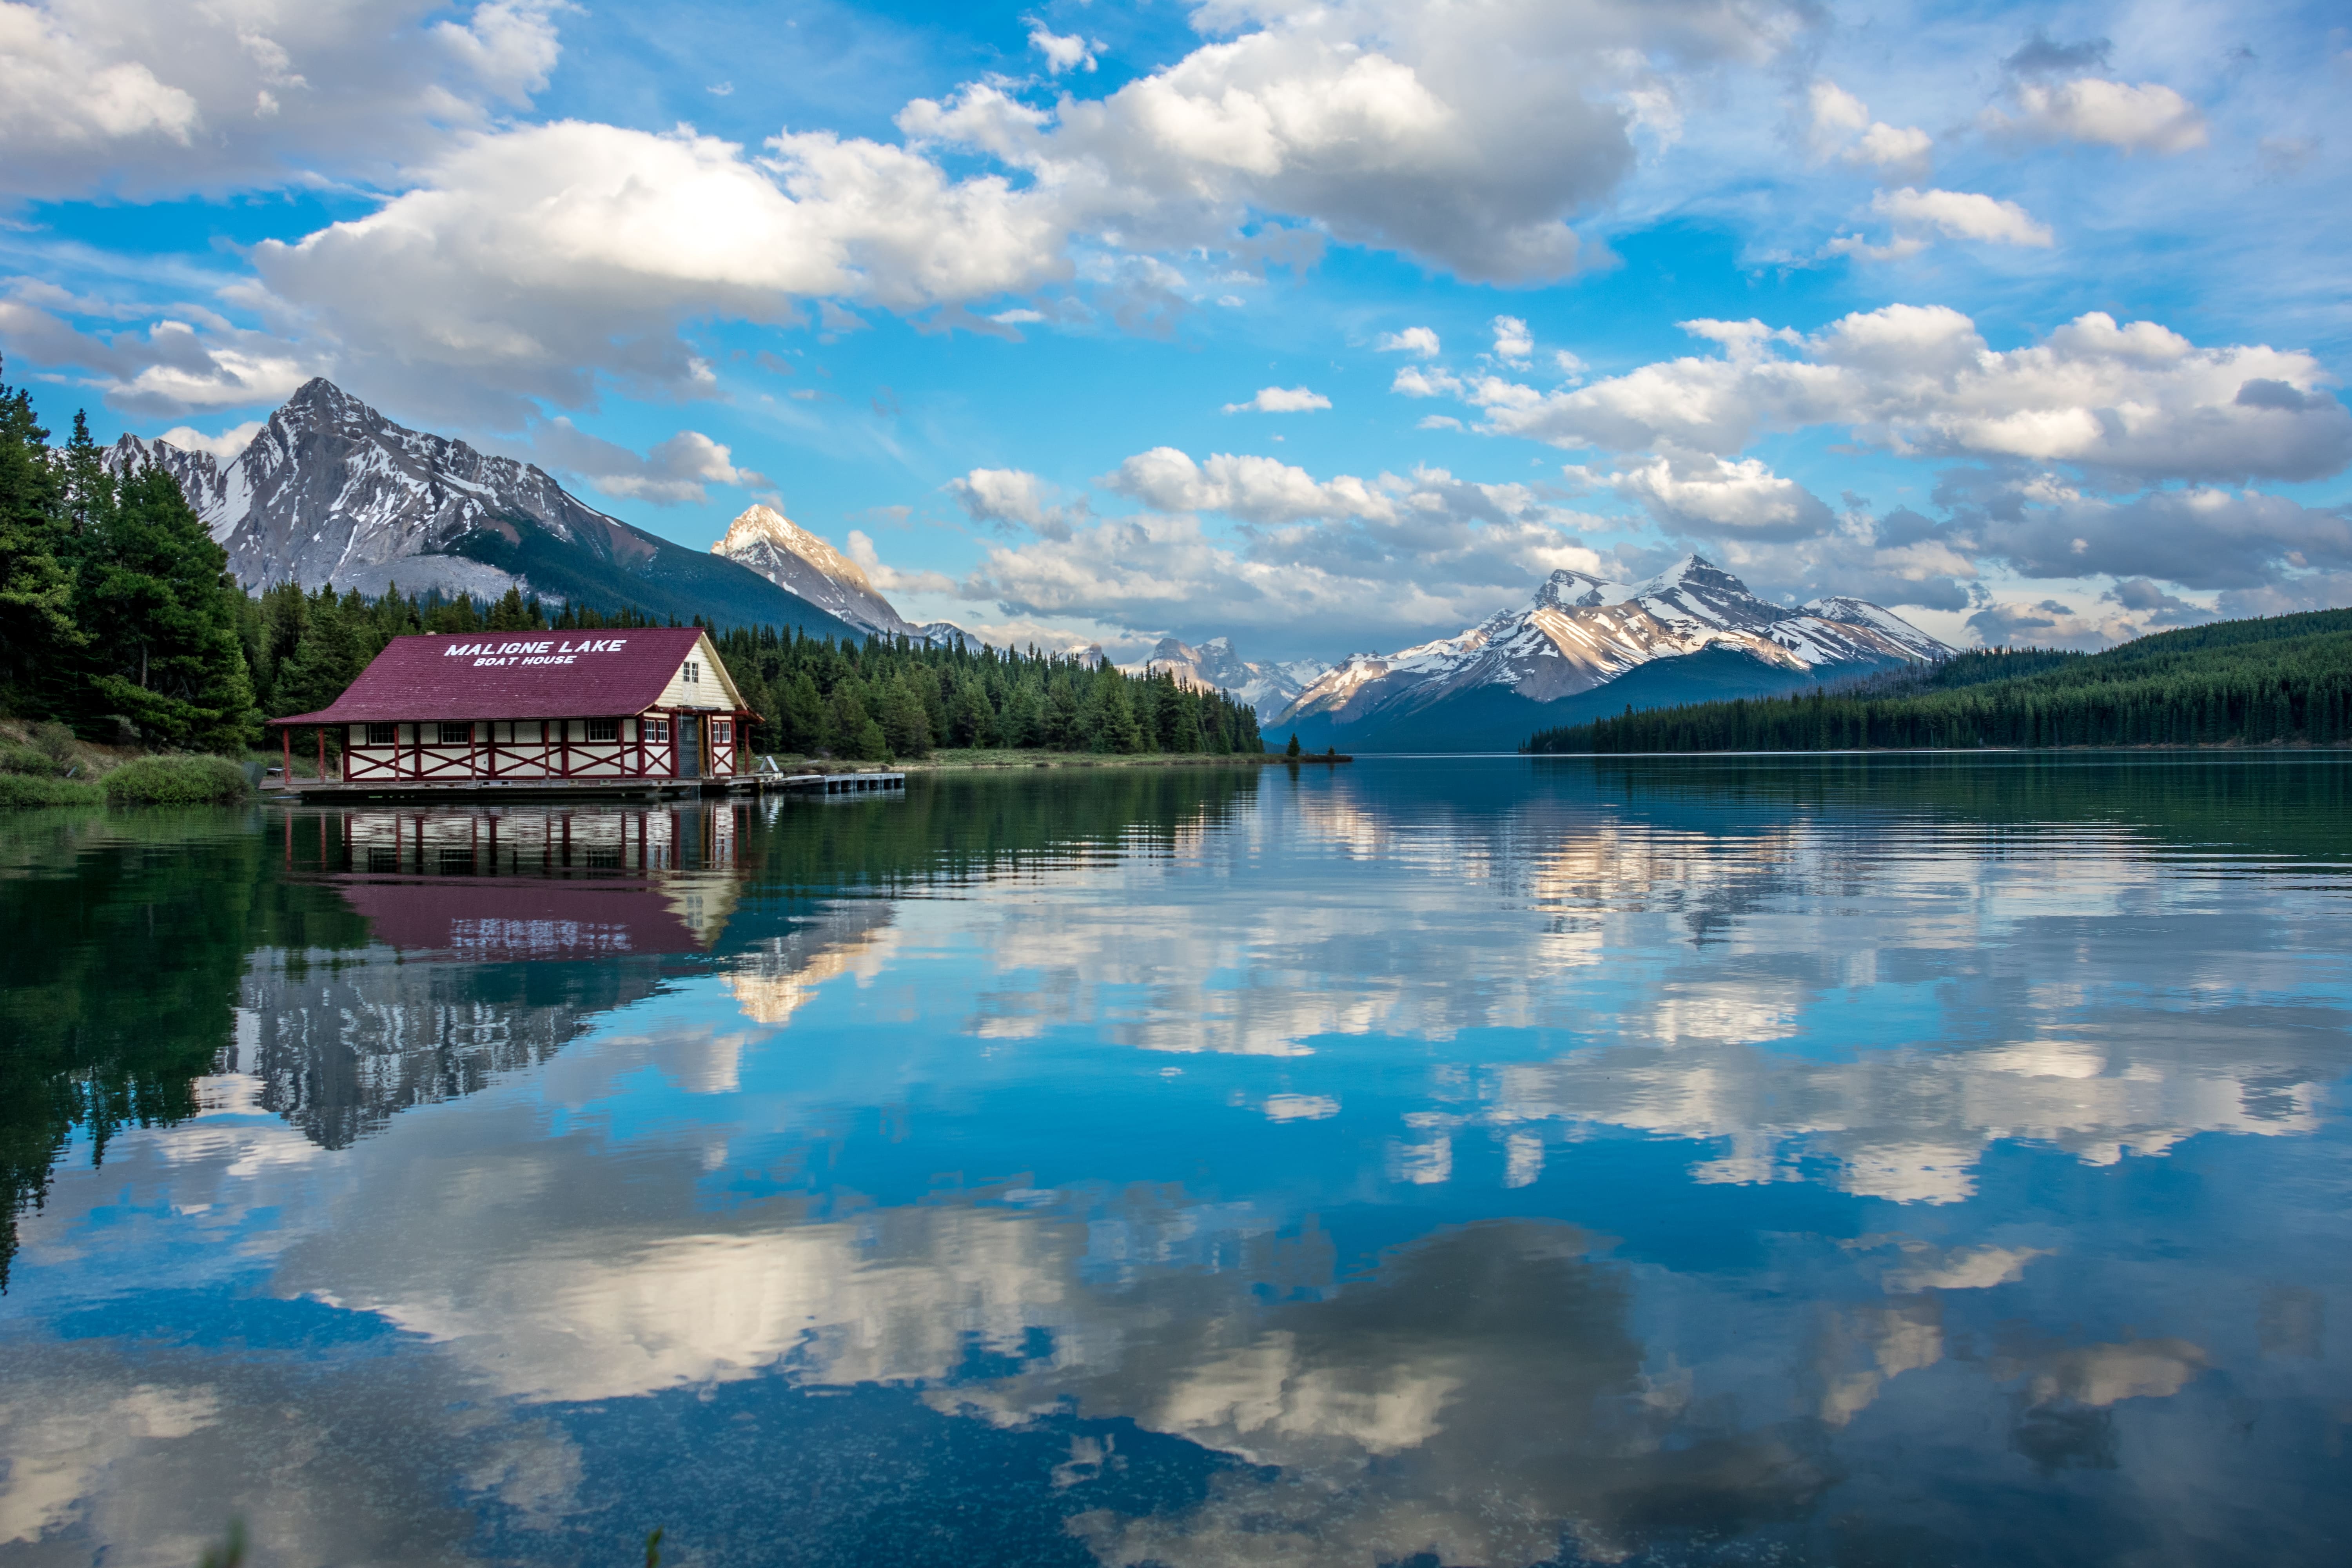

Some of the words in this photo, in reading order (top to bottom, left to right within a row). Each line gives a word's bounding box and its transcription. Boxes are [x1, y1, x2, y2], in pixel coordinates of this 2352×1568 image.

[444, 642, 554, 656] MALIGNE
[558, 640, 627, 652] LAKE
[474, 657, 519, 666] BOAT
[521, 655, 577, 665] HOUSE
